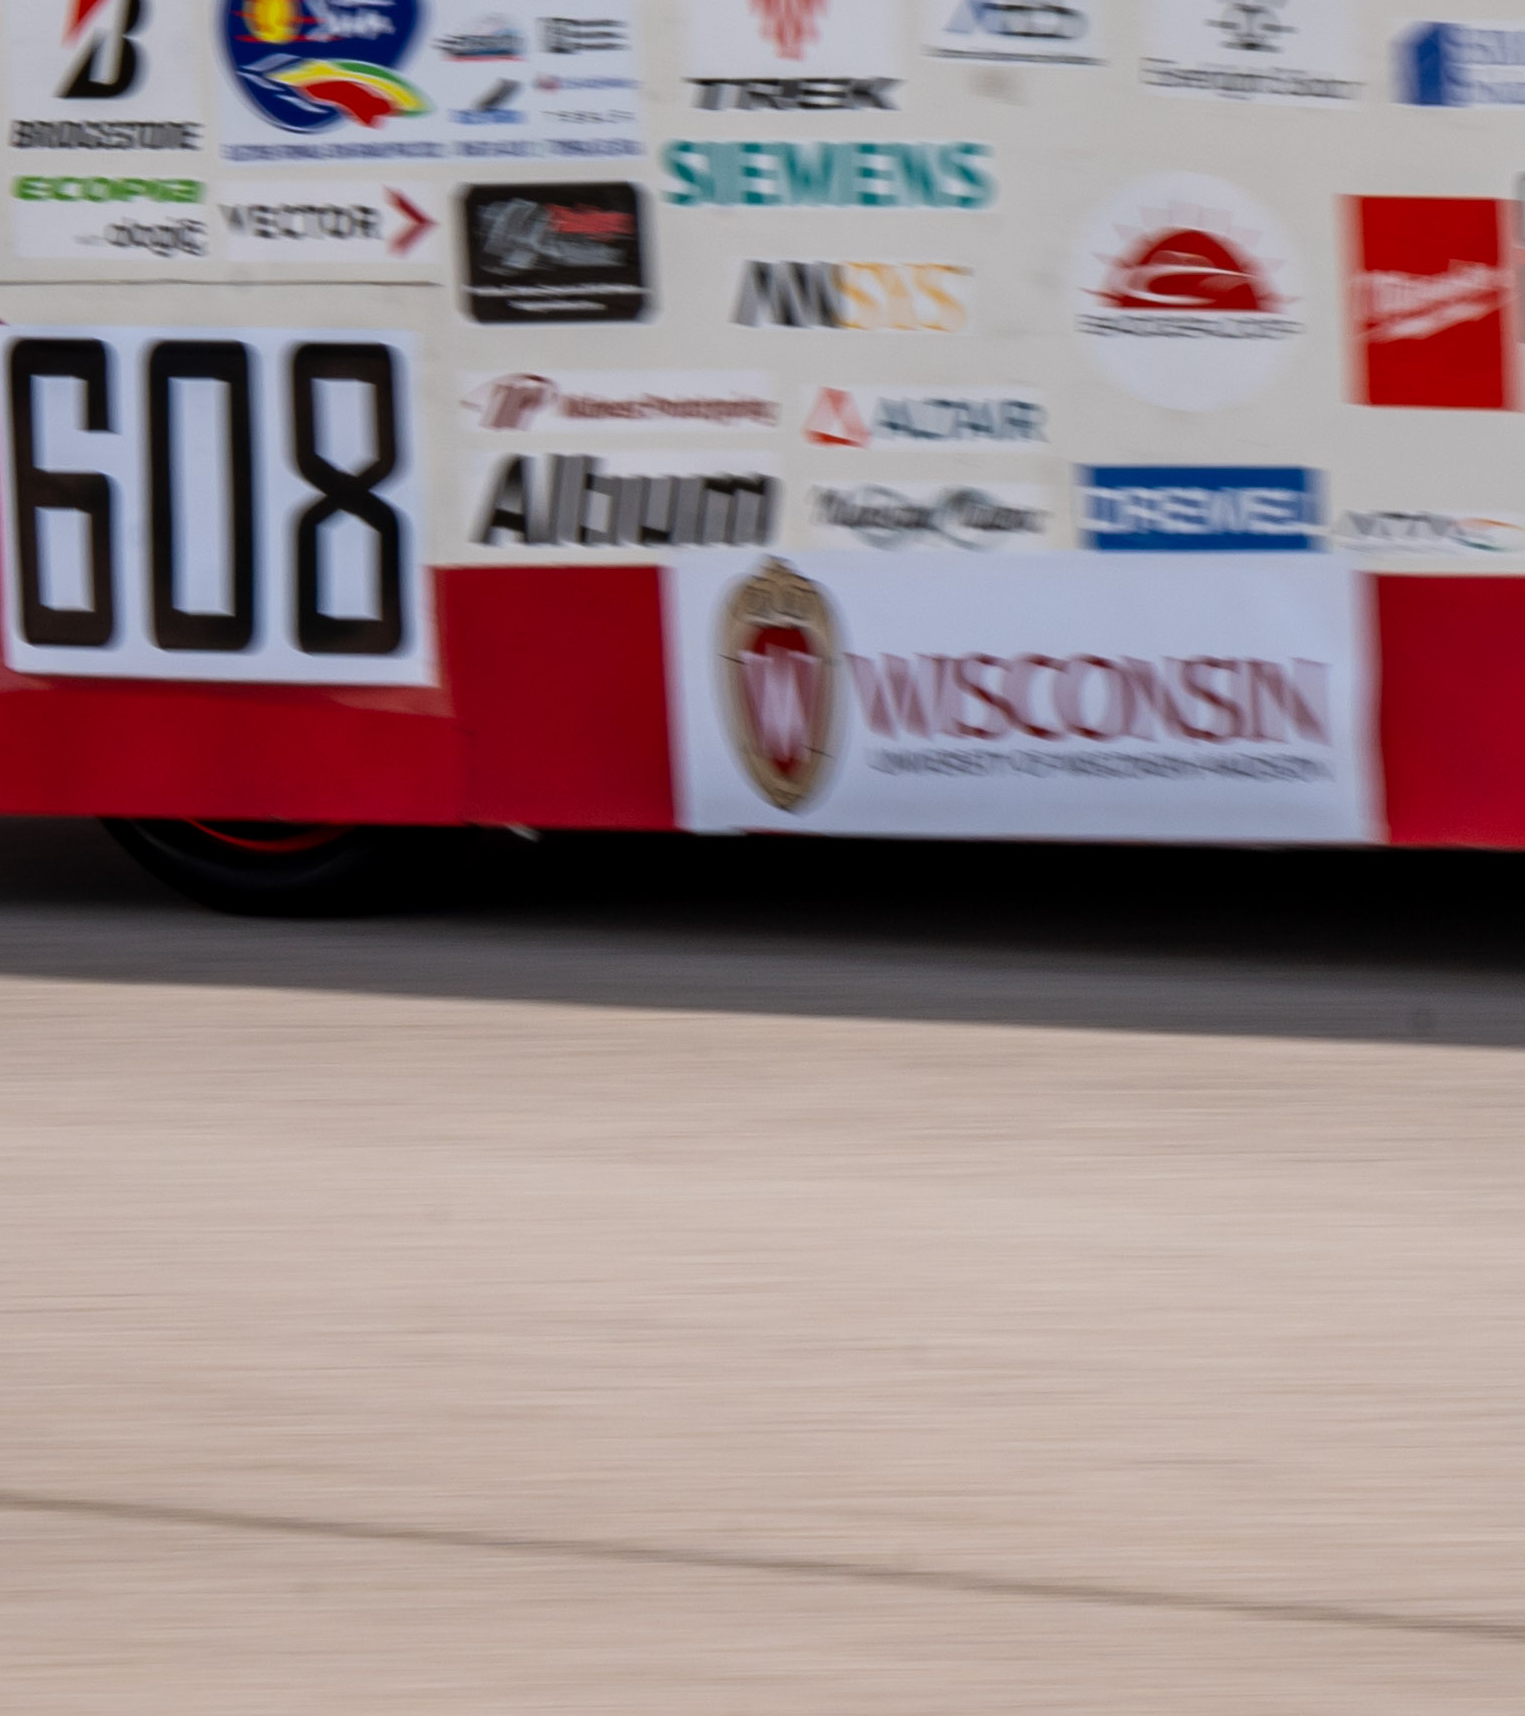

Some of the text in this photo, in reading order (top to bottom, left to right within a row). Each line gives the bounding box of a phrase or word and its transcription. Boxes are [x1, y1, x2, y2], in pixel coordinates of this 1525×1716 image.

[682, 77, 904, 111] TREK
[10, 120, 204, 150] BRIDGESTONE
[662, 138, 996, 208] SIEMENS
[218, 204, 380, 239] VECTOR
[730, 260, 973, 332] ANSYS
[876, 397, 1048, 441] ALTAIR
[9, 337, 406, 655] 608
[470, 454, 778, 545] Album
[1082, 486, 1324, 535] DREMEL
[843, 652, 1331, 745] WISCONSIN
